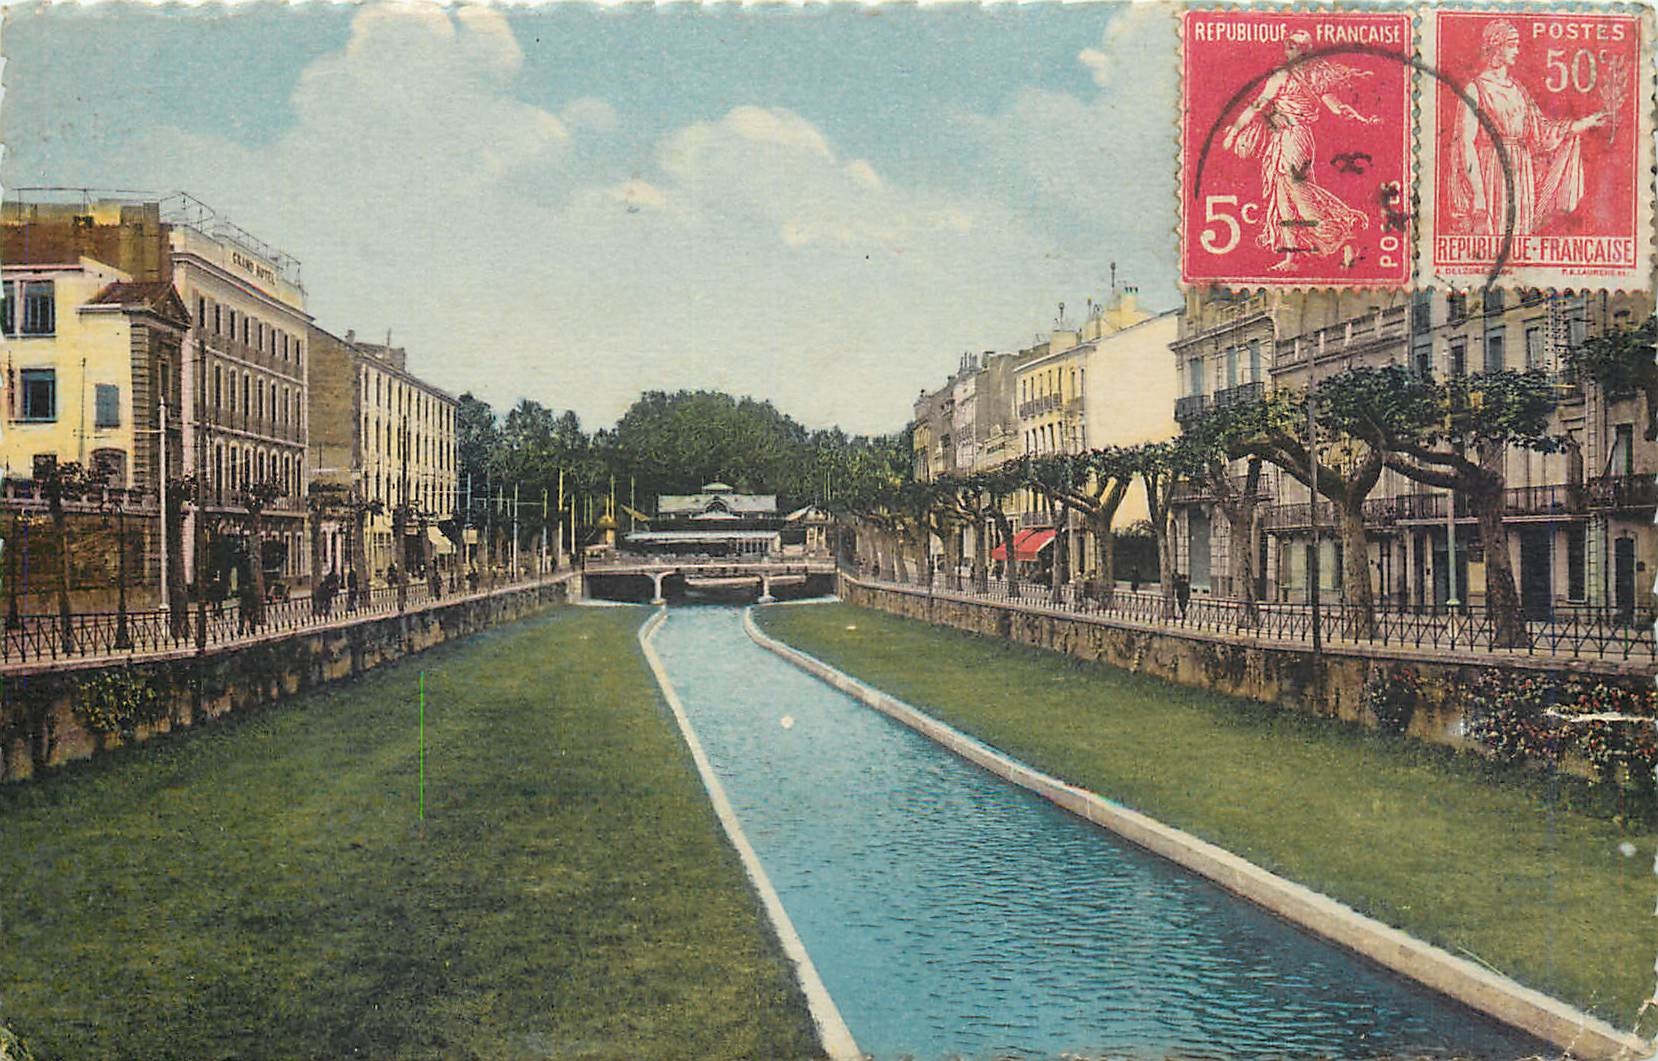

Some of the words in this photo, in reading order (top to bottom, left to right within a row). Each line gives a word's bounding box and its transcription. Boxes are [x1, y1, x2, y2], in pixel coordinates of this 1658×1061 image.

[1532, 22, 1625, 41] POSTES
[1379, 180, 1401, 268] POSES
[232, 251, 255, 274] GRAND
